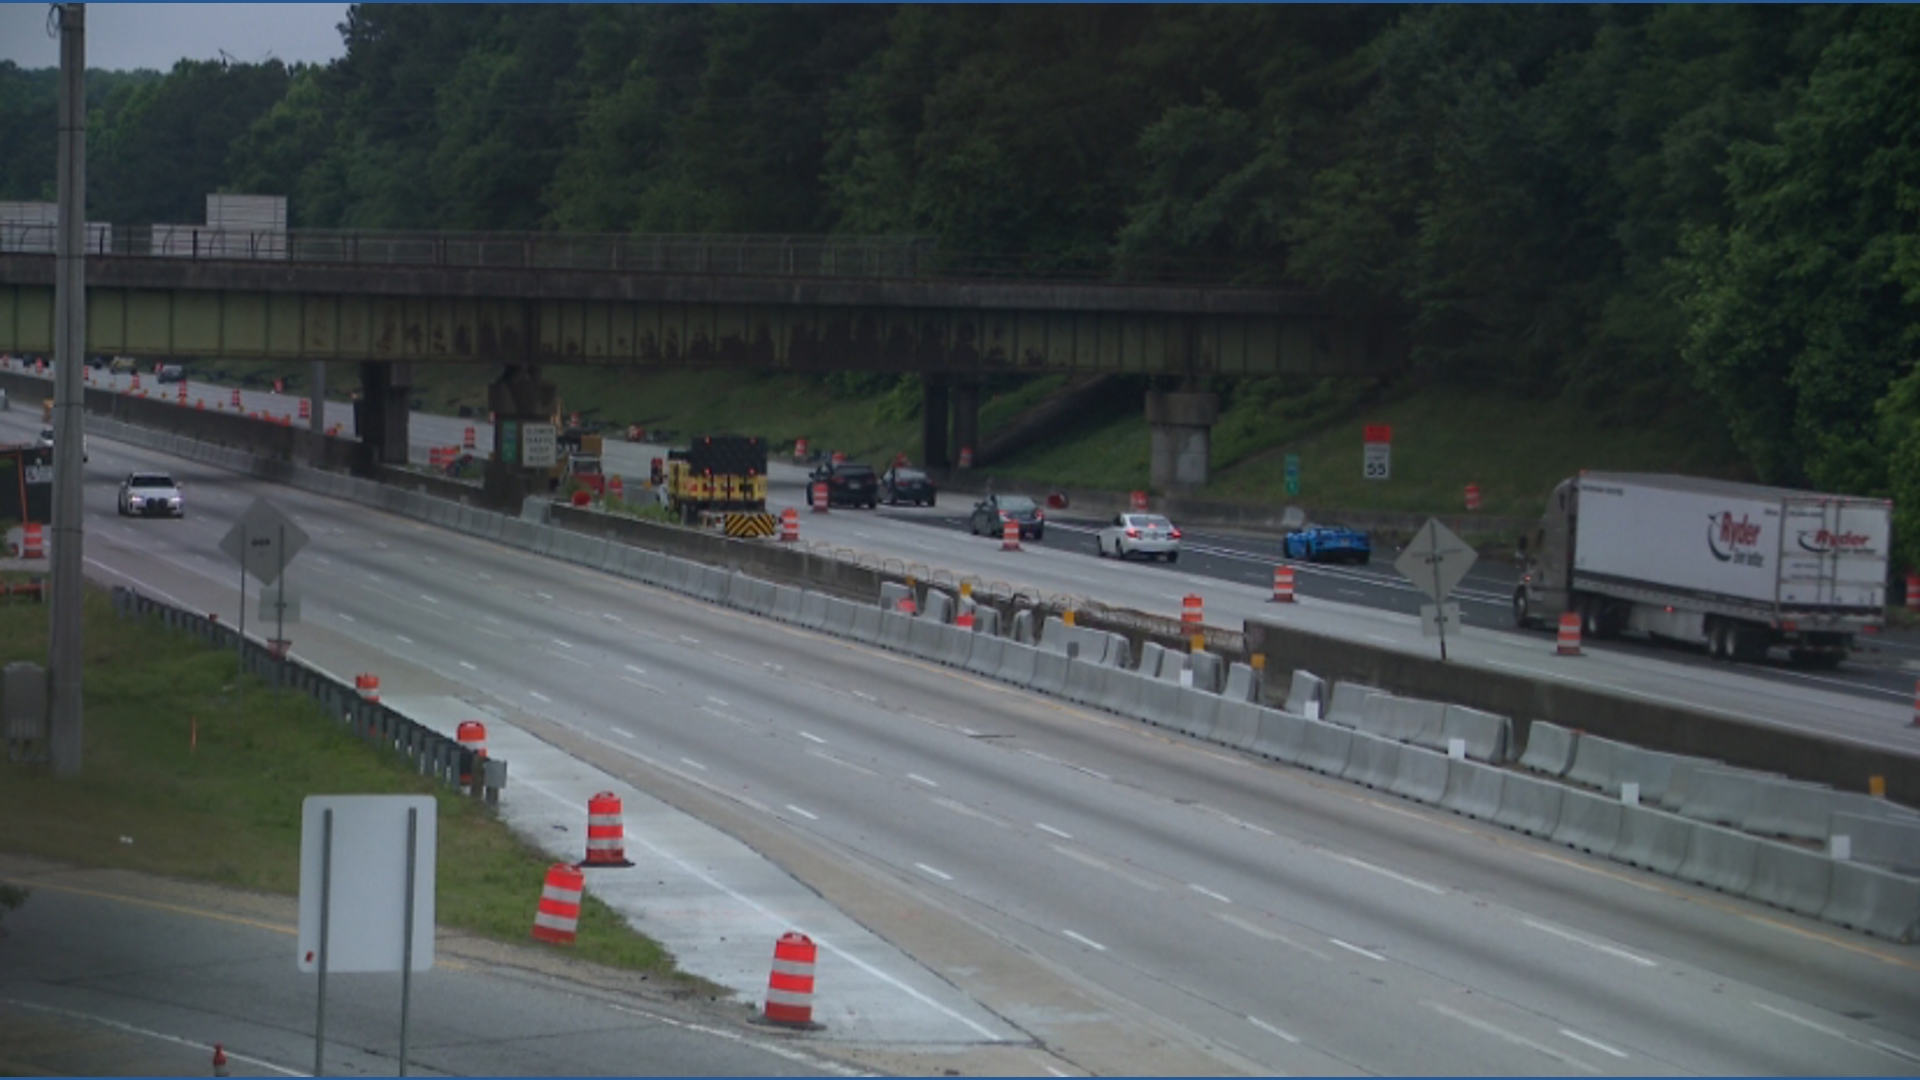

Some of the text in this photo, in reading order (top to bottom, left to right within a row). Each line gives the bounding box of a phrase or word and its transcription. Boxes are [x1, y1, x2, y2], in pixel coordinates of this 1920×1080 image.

[1367, 463, 1386, 475] 55
[1719, 511, 1762, 551] Ryder
[1814, 529, 1870, 548] Ryder
